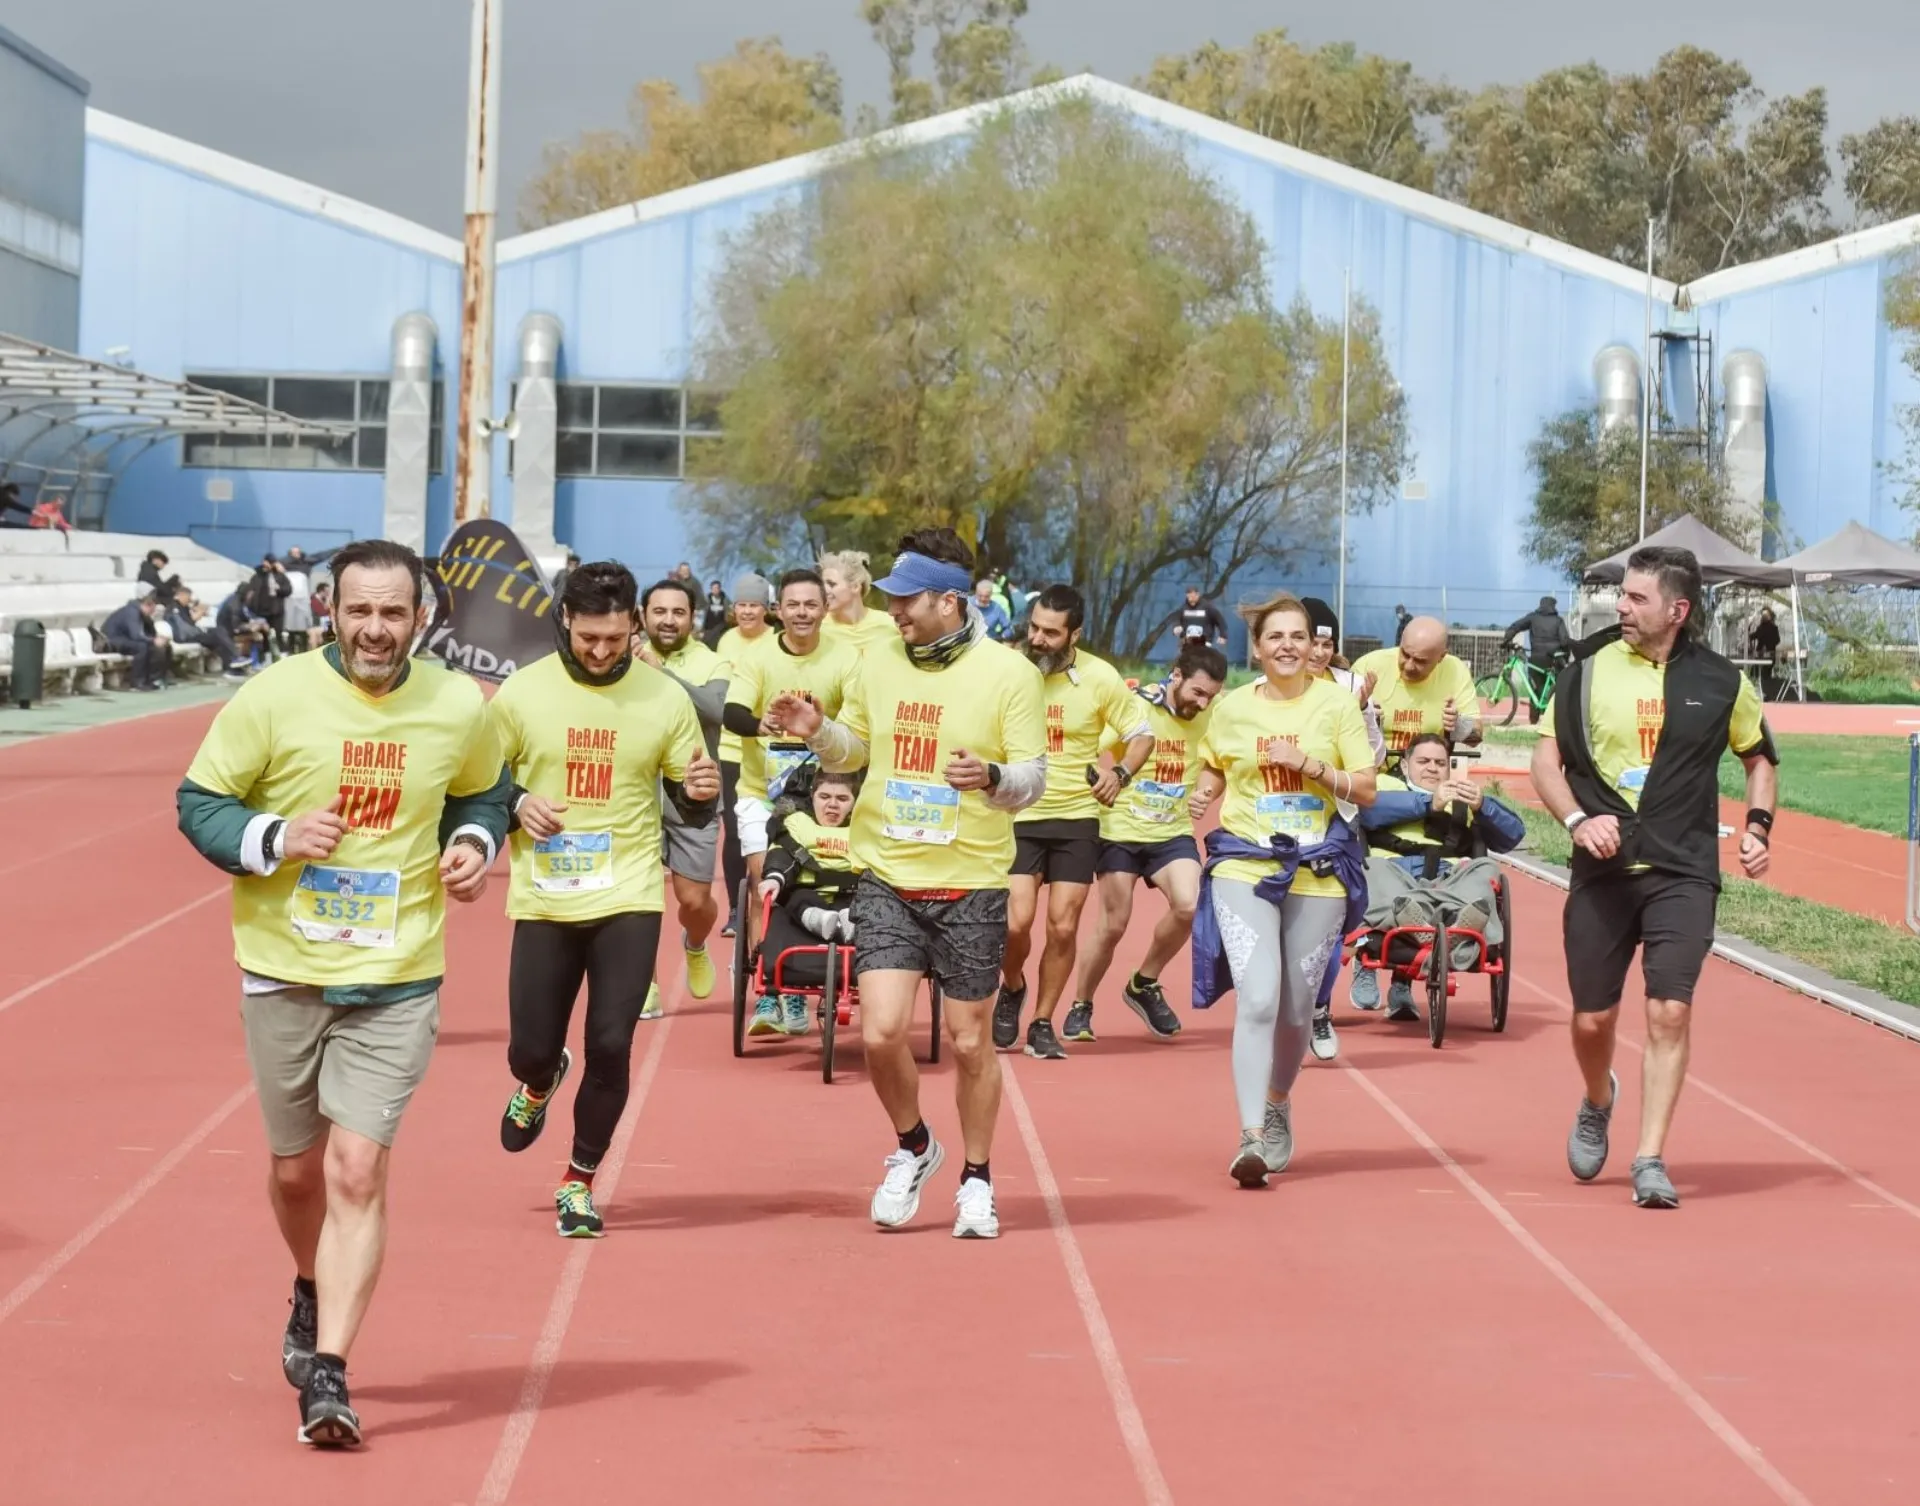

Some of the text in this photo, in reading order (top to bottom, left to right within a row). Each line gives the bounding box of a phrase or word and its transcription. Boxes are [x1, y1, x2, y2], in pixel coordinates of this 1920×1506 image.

[445, 636, 517, 680] MDA
[896, 700, 944, 726] BeRARE
[567, 727, 617, 750] BeRARE
[342, 740, 407, 770] BeRARE
[893, 733, 938, 774] TEAM
[566, 762, 613, 800] TEAM
[1155, 761, 1185, 784] TEAM
[1258, 763, 1303, 792] TEAM
[337, 784, 402, 830] TEAM
[895, 805, 941, 825] 3528
[550, 856, 594, 873] 3513
[314, 897, 375, 921] 3532
